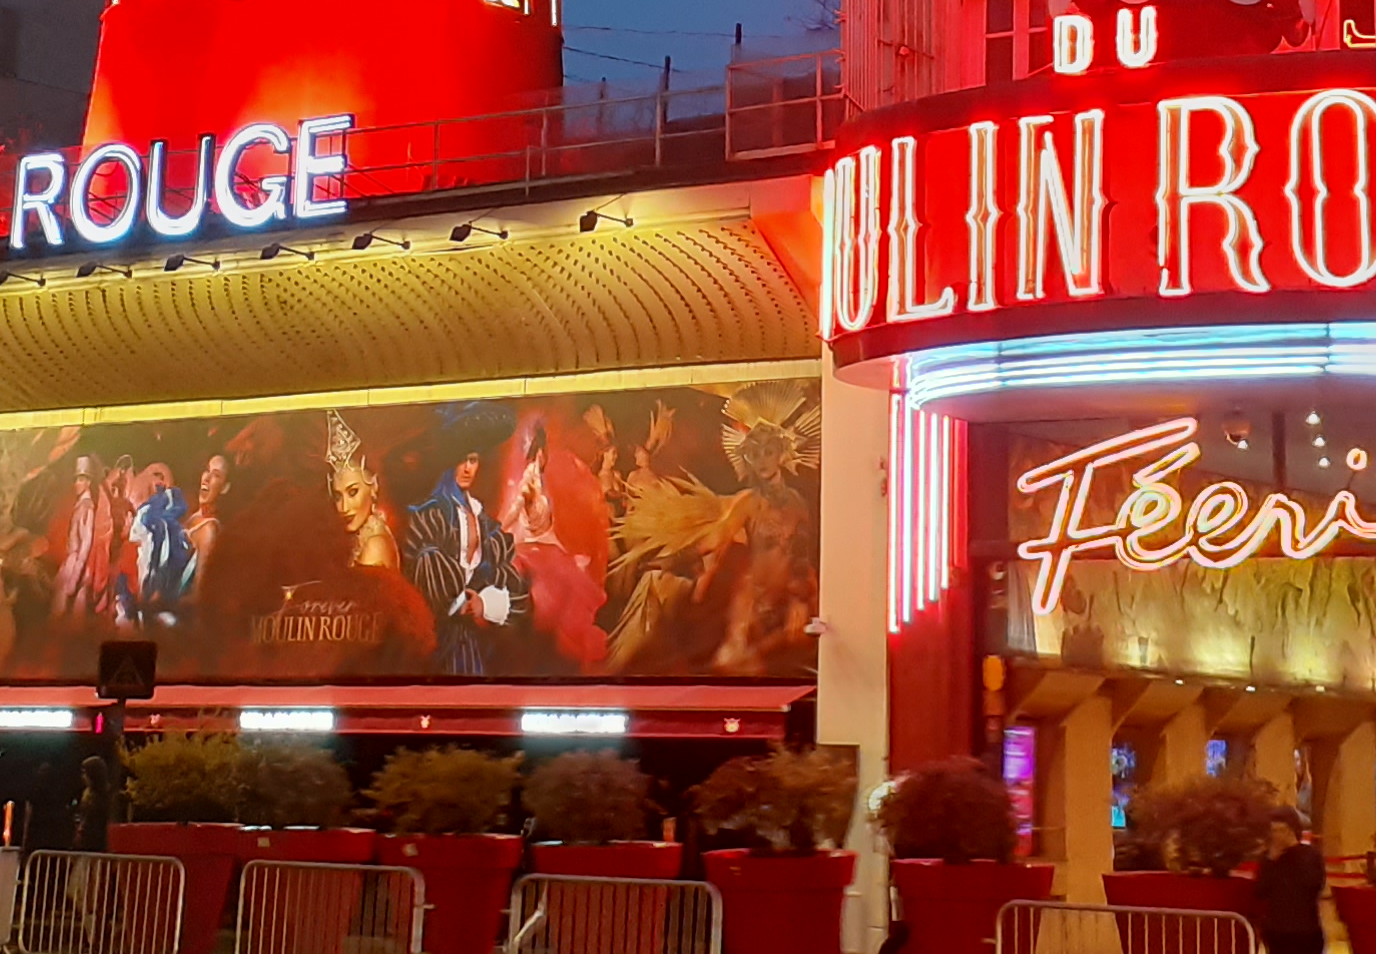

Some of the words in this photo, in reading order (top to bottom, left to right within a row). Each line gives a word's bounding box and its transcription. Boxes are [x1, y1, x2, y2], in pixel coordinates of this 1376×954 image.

[1053, 6, 1158, 74] DU
[9, 113, 353, 249] ROUGE
[821, 108, 1108, 340] ULIN
[252, 615, 316, 644] MOULIN
[319, 613, 382, 643] ROUGE
